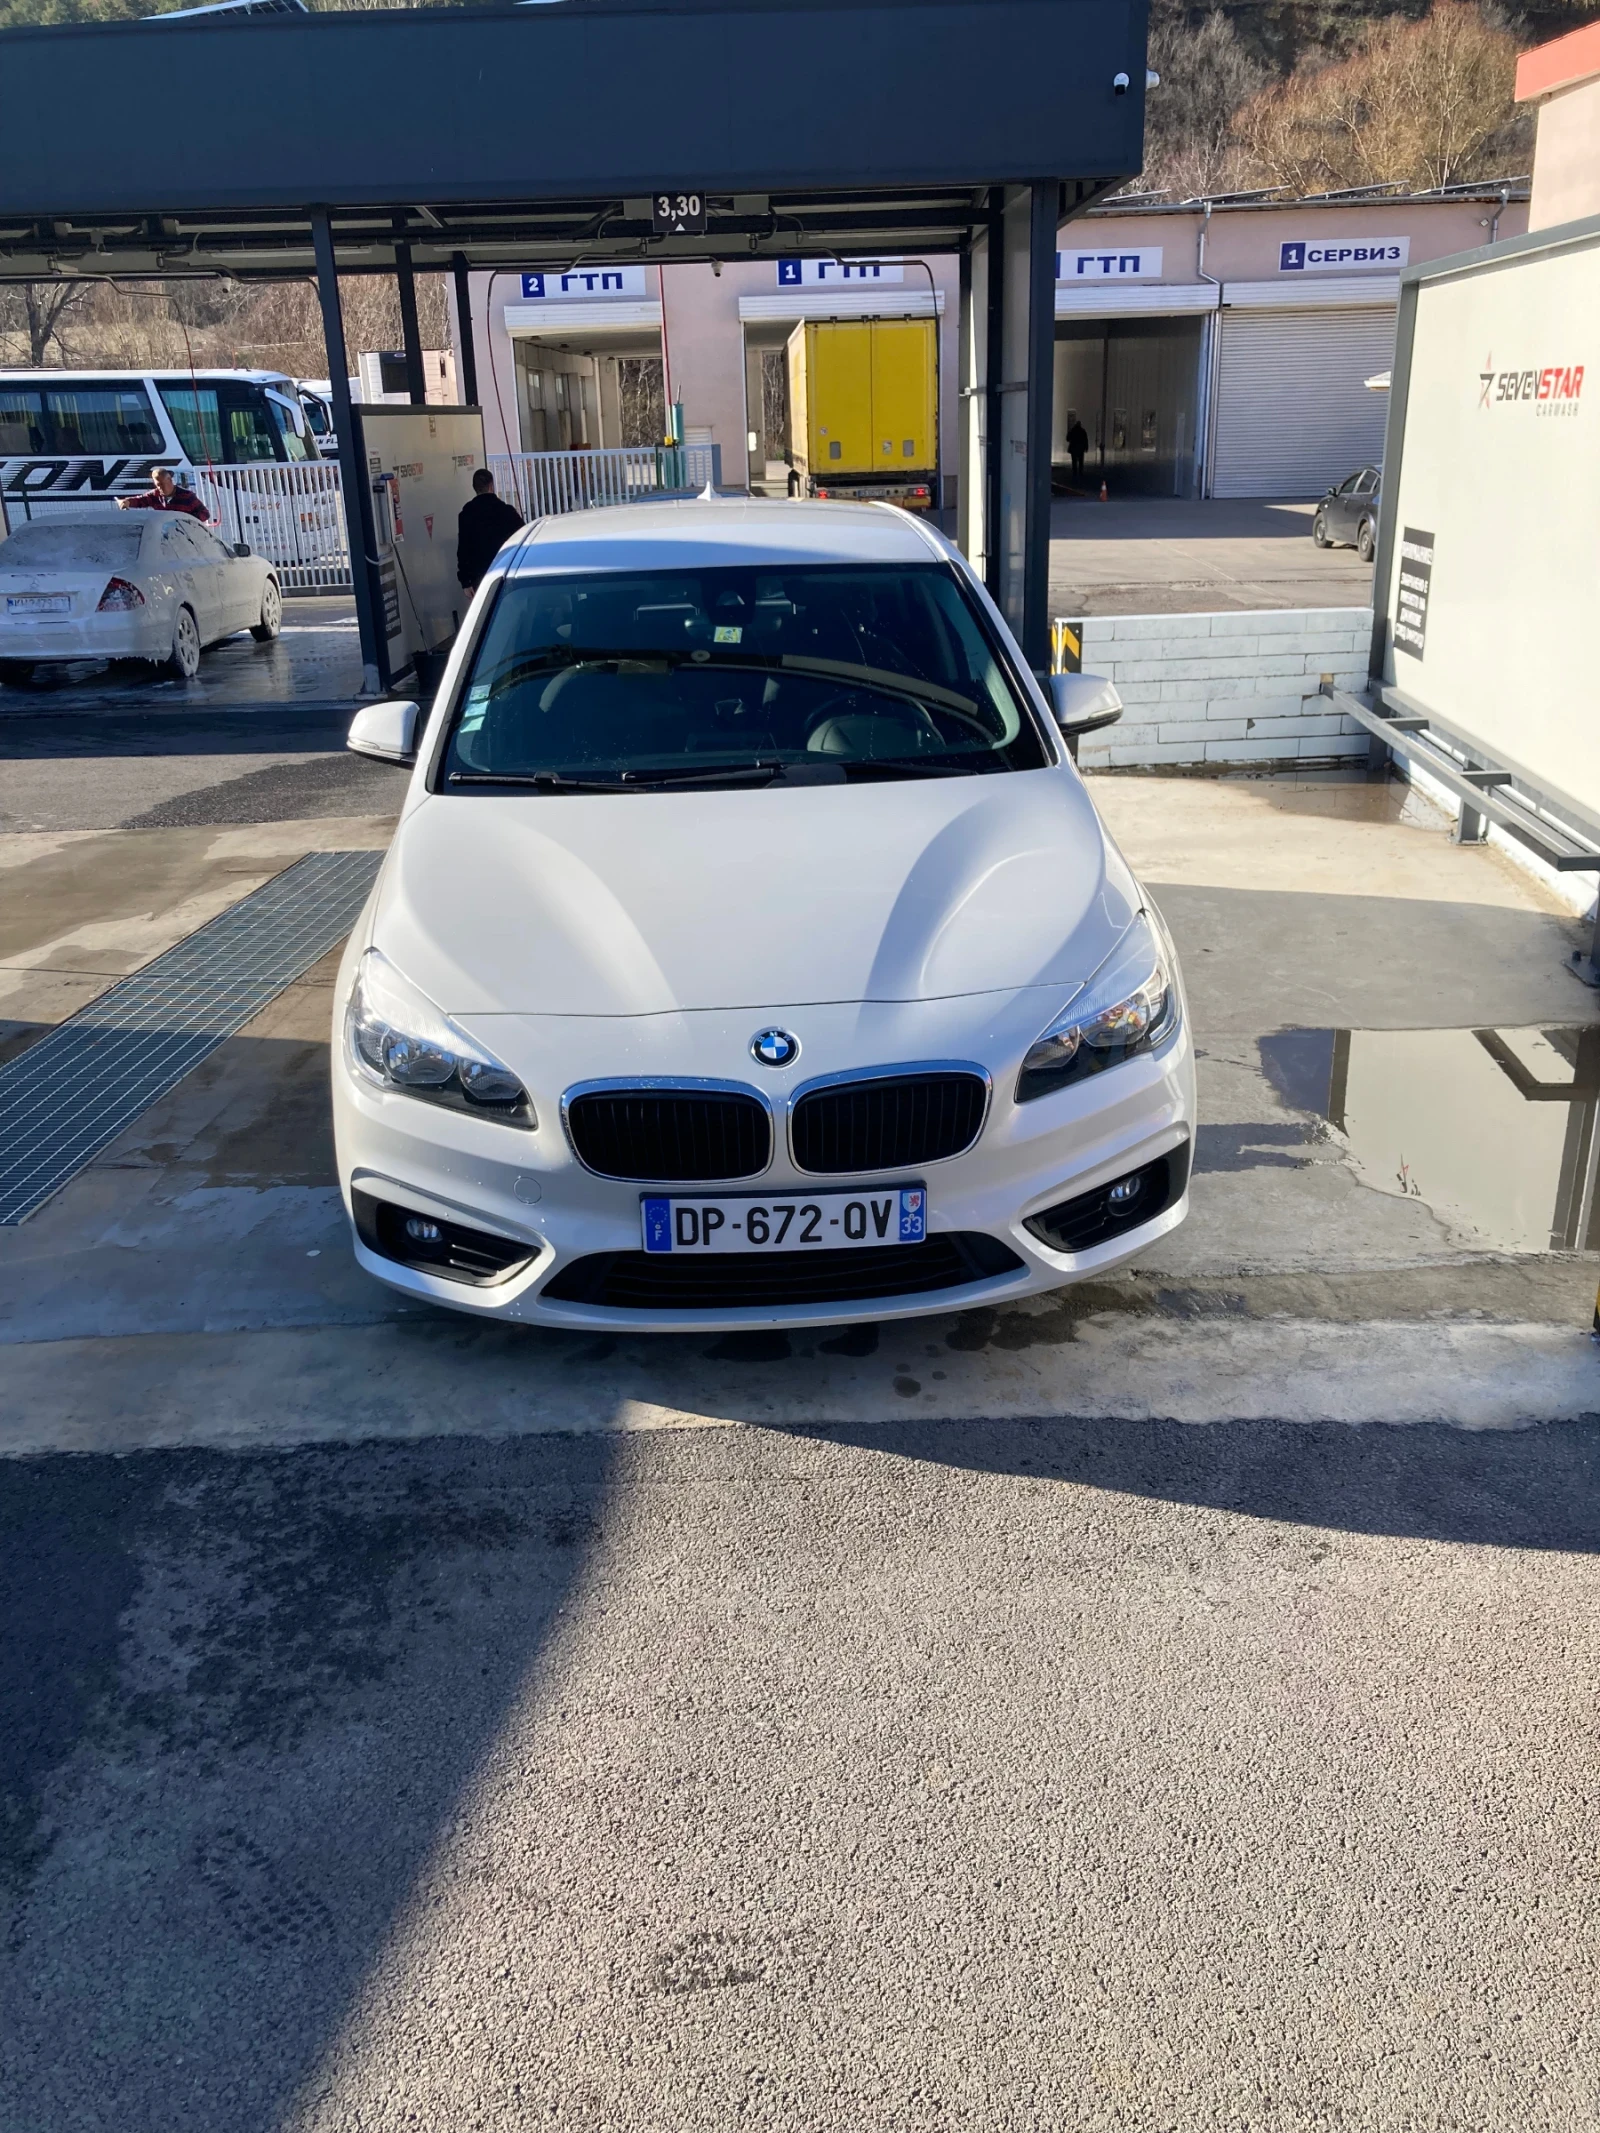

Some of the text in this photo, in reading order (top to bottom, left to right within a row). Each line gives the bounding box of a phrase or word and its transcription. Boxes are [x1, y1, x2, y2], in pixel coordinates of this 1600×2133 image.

[658, 195, 701, 222] 3,30
[1077, 254, 1141, 274] ГТП
[1287, 245, 1401, 264] 1 СЕРВИЗ
[785, 264, 796, 279] 1
[528, 272, 623, 292] 2 ГТП
[655, 1199, 923, 1246] F DP-672-QV 33
